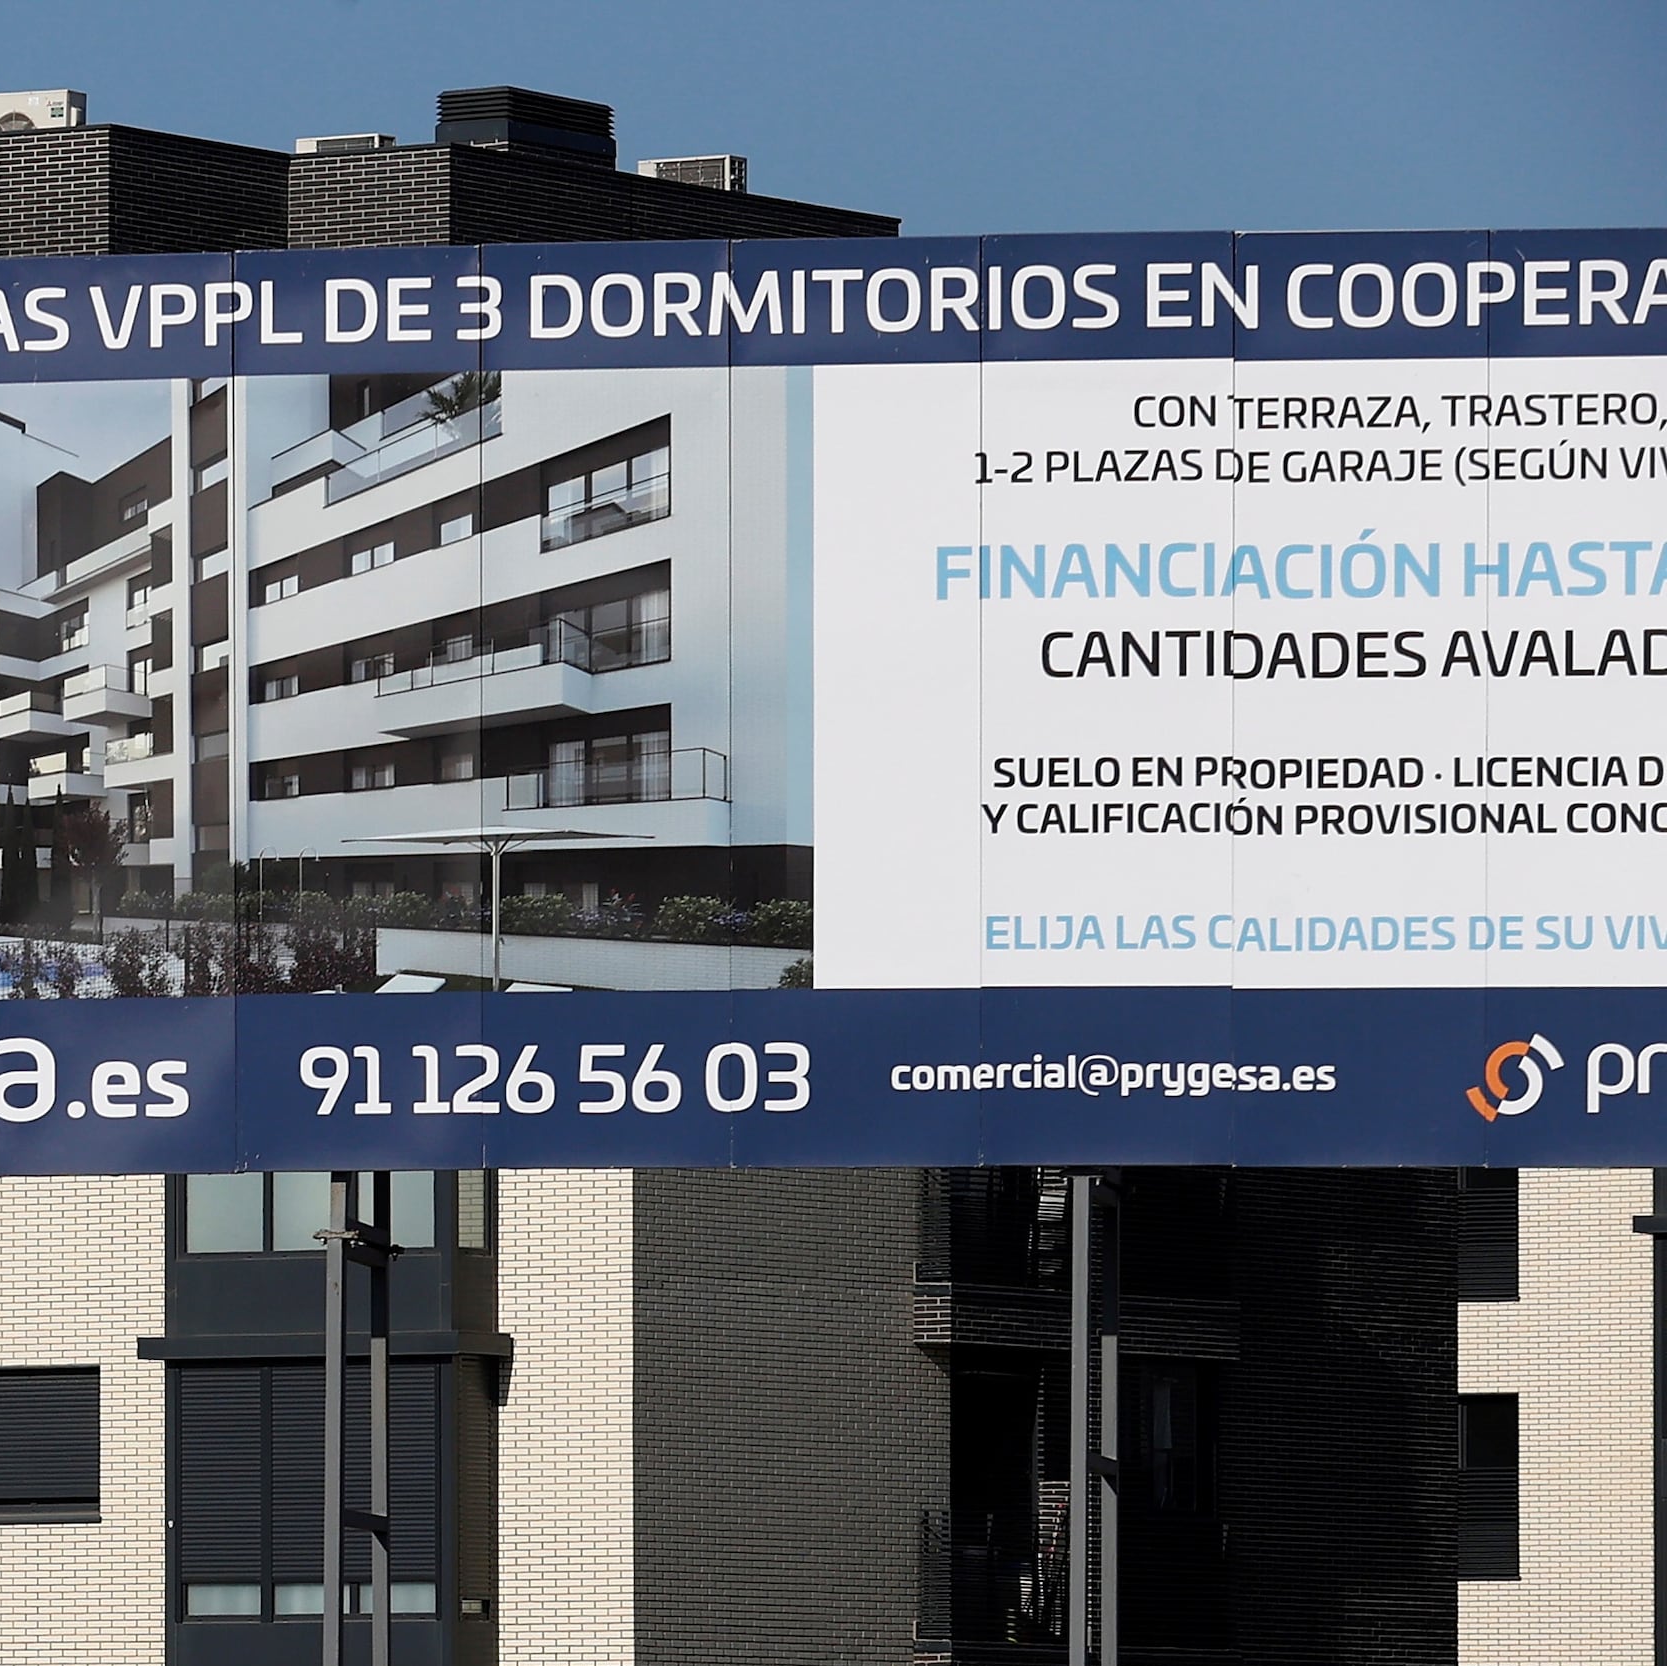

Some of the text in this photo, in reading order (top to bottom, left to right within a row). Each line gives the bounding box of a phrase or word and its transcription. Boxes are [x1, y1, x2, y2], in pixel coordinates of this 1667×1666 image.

[91, 280, 301, 349] VPPL
[326, 278, 431, 342] DE
[457, 275, 502, 340] 3
[531, 264, 1119, 338] DORMITORIOS
[1147, 263, 1258, 328] EN
[1135, 393, 1667, 433] CON TERRAZA, TRASTERO,
[975, 452, 1032, 484] 1-2
[1047, 450, 1202, 482] PLAZAS
[1216, 448, 1270, 483] DE
[1283, 450, 1442, 482] GARAJE
[1455, 440, 1606, 486] (SEGÚN
[936, 530, 1441, 600] FINANCIACIÓN
[1042, 630, 1426, 679] CANTIDADES
[994, 757, 1120, 787] SUELO
[1133, 757, 1182, 786] EN
[1196, 756, 1423, 789] PROPIEDAD
[1454, 757, 1628, 787] LICENCIA
[981, 804, 1008, 833] Y
[1017, 797, 1282, 835] CALIFICACIÓN
[1296, 804, 1557, 835] PROVISIONAL
[986, 915, 1105, 949] ELIJA
[1117, 915, 1196, 949] LAS
[1209, 915, 1455, 952] CALIDADES
[1469, 916, 1523, 950] DE
[1536, 916, 1593, 950] SU
[300, 1042, 809, 1114] 91 126 56 03
[892, 1054, 1335, 1096] comercial@prygesa.es
